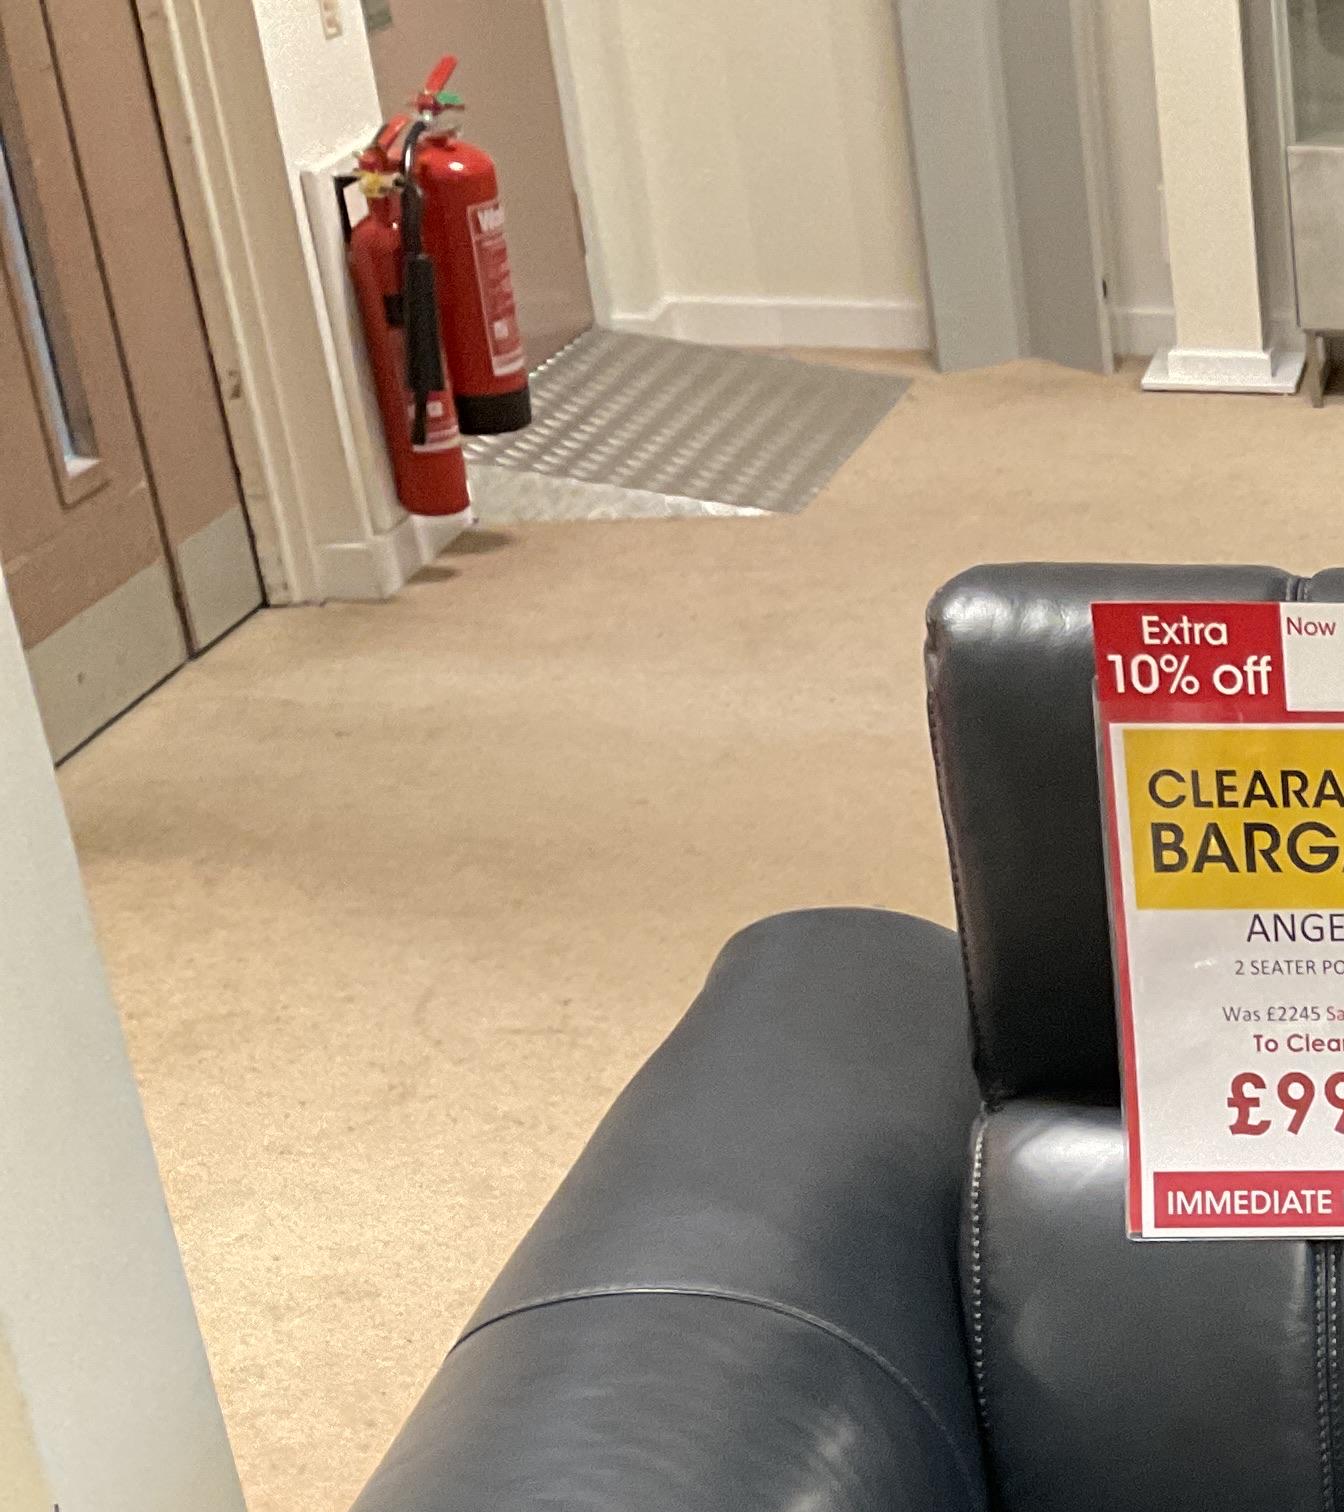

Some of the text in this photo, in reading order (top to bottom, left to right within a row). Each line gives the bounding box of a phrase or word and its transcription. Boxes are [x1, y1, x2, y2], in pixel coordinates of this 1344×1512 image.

[1141, 615, 1228, 646] Extra
[1286, 618, 1336, 636] Now
[1106, 654, 1273, 695] 10% off
[1234, 960, 1245, 976] 2
[1250, 960, 1317, 976] SEATER
[1222, 1007, 1261, 1022] Was
[1267, 1005, 1321, 1022] £2245
[1253, 1034, 1279, 1053] To
[1167, 1189, 1332, 1215] IMMEDIATE
